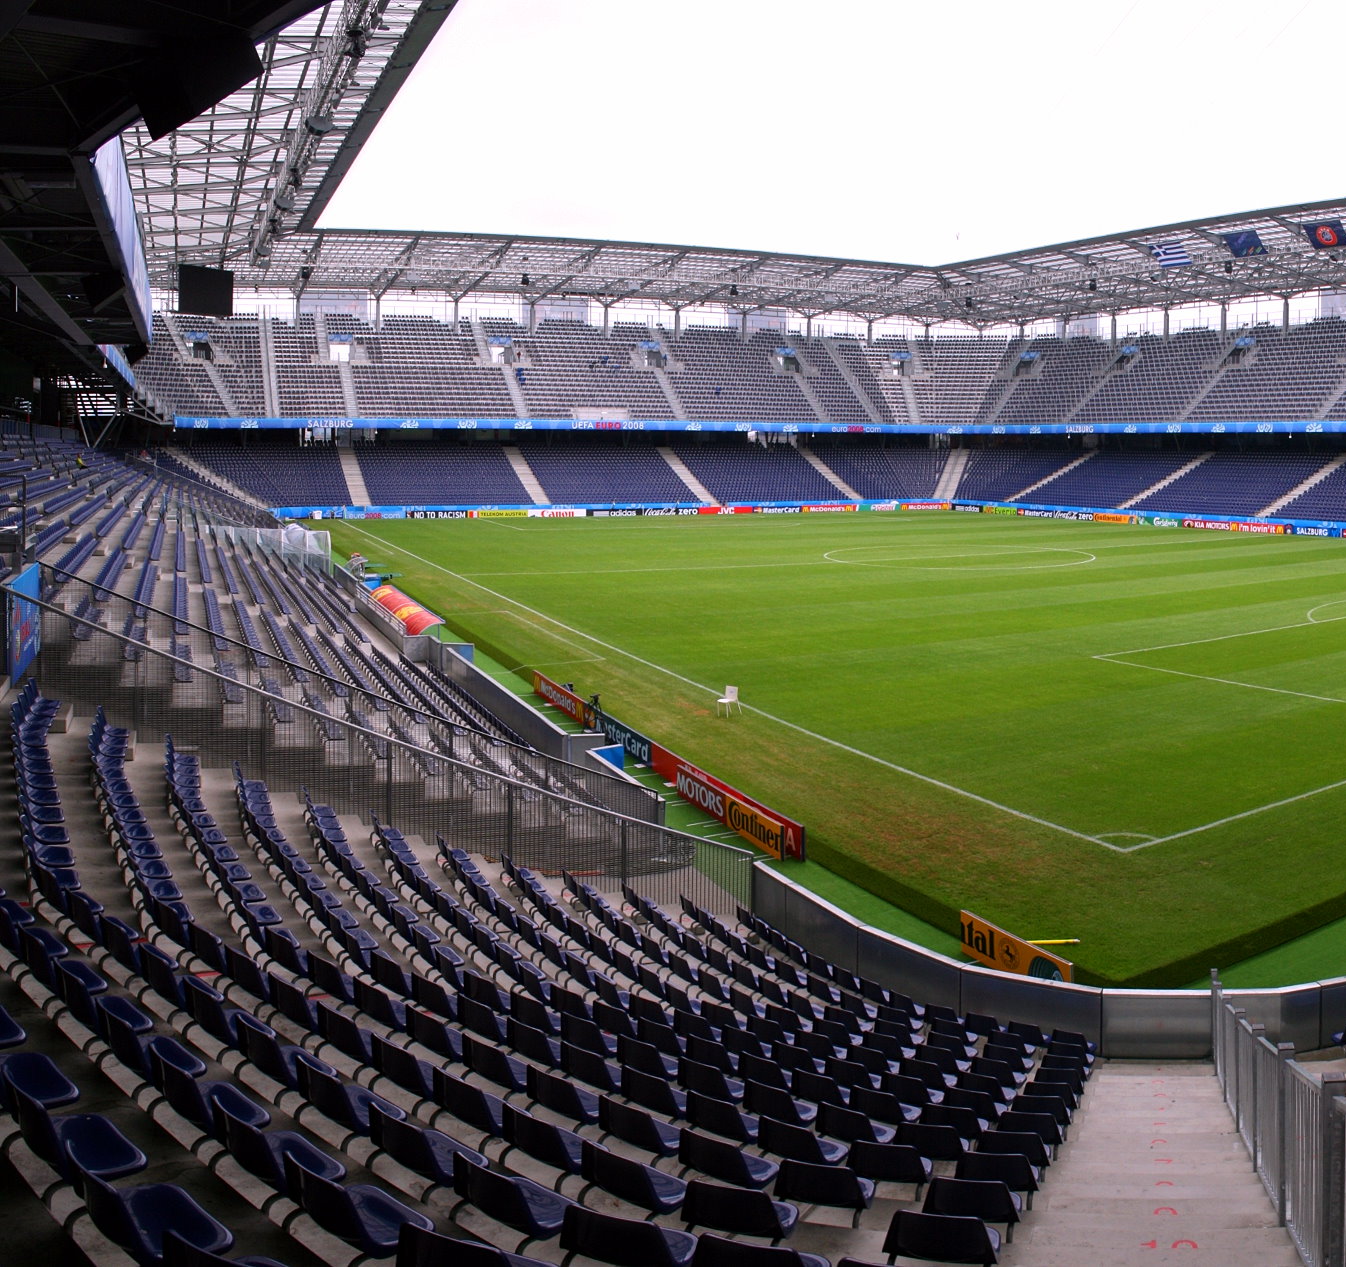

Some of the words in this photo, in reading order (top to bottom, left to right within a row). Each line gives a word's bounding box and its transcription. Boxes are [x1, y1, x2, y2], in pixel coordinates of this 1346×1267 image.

[308, 420, 353, 428] SALZBURG
[572, 421, 594, 430] UEFA
[595, 421, 621, 430] EURO
[623, 421, 644, 430] 2008
[1065, 425, 1094, 433] SALZBURG
[763, 506, 800, 514] MasterCard
[810, 505, 845, 513] McDonald's
[908, 503, 942, 511] McDonald's
[414, 511, 424, 519] NO
[426, 511, 435, 519] TO
[438, 511, 466, 519] RACISM
[541, 510, 574, 518] Canon
[678, 508, 698, 516] zero
[1024, 510, 1052, 518] MasterCard
[1078, 512, 1093, 521] zero
[1093, 513, 1122, 522] Continental
[1153, 517, 1178, 527] Carlsberg
[1206, 522, 1230, 530] MOTORS
[1296, 526, 1328, 536] SALZBURG
[541, 680, 576, 715] McDonald's
[596, 717, 648, 761] MsterCard
[676, 771, 724, 817] MOTORS
